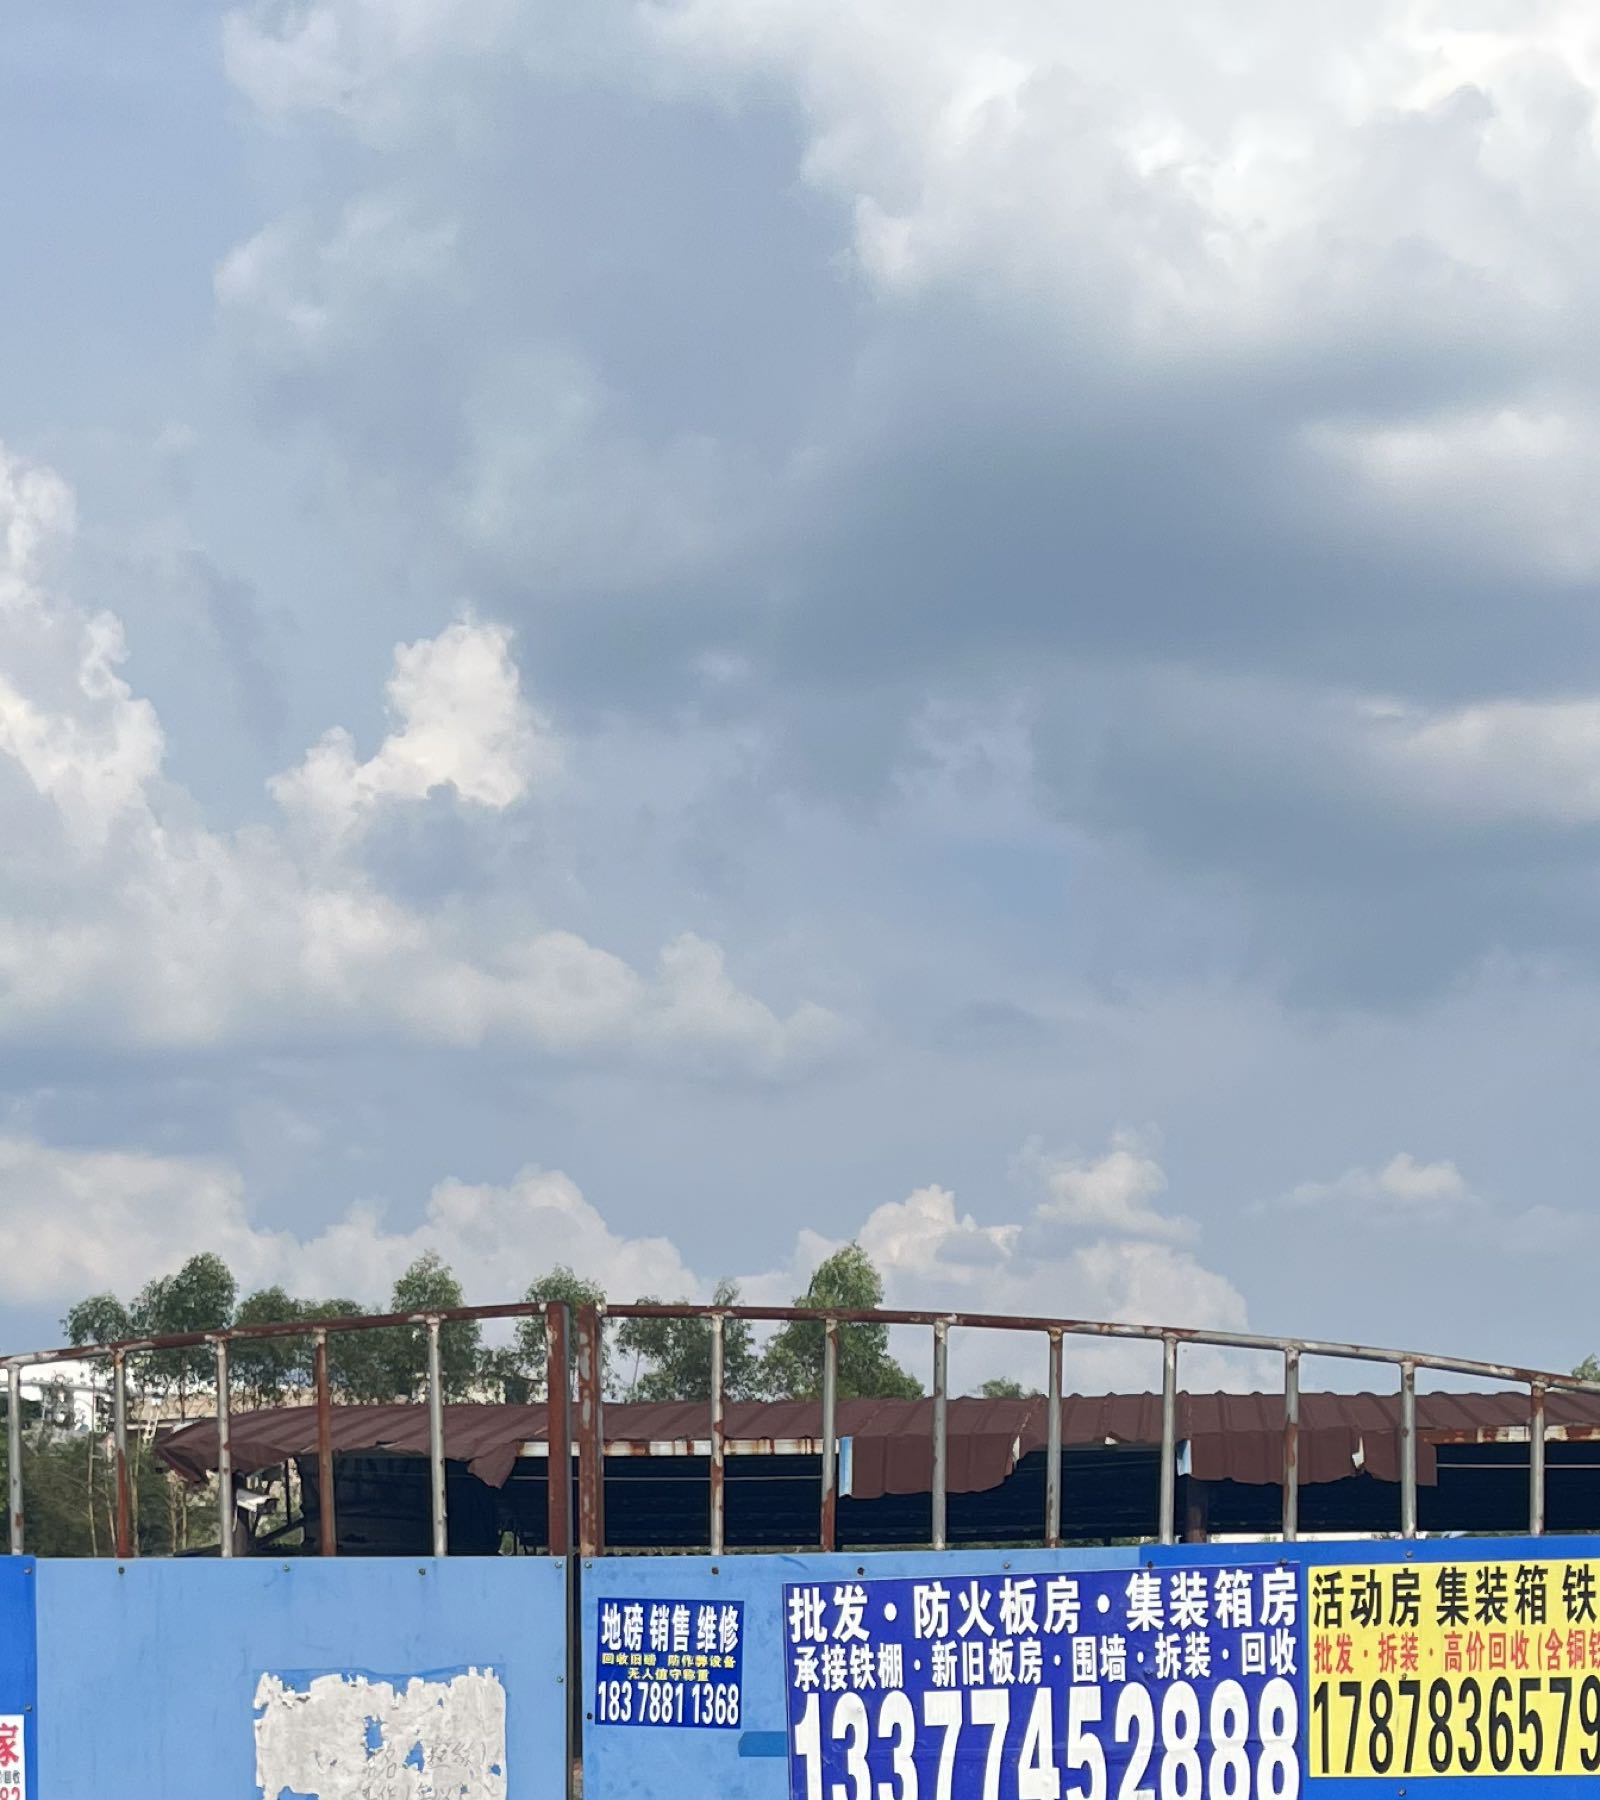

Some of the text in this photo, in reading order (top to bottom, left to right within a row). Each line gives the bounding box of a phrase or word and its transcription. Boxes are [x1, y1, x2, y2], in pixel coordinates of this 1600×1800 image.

[1312, 1567, 1421, 1629] 活动房
[1435, 1563, 1549, 1627] 集装箱
[601, 1602, 739, 1653] 地磅 销售 维修
[598, 1680, 739, 1725] 183 7881 1368
